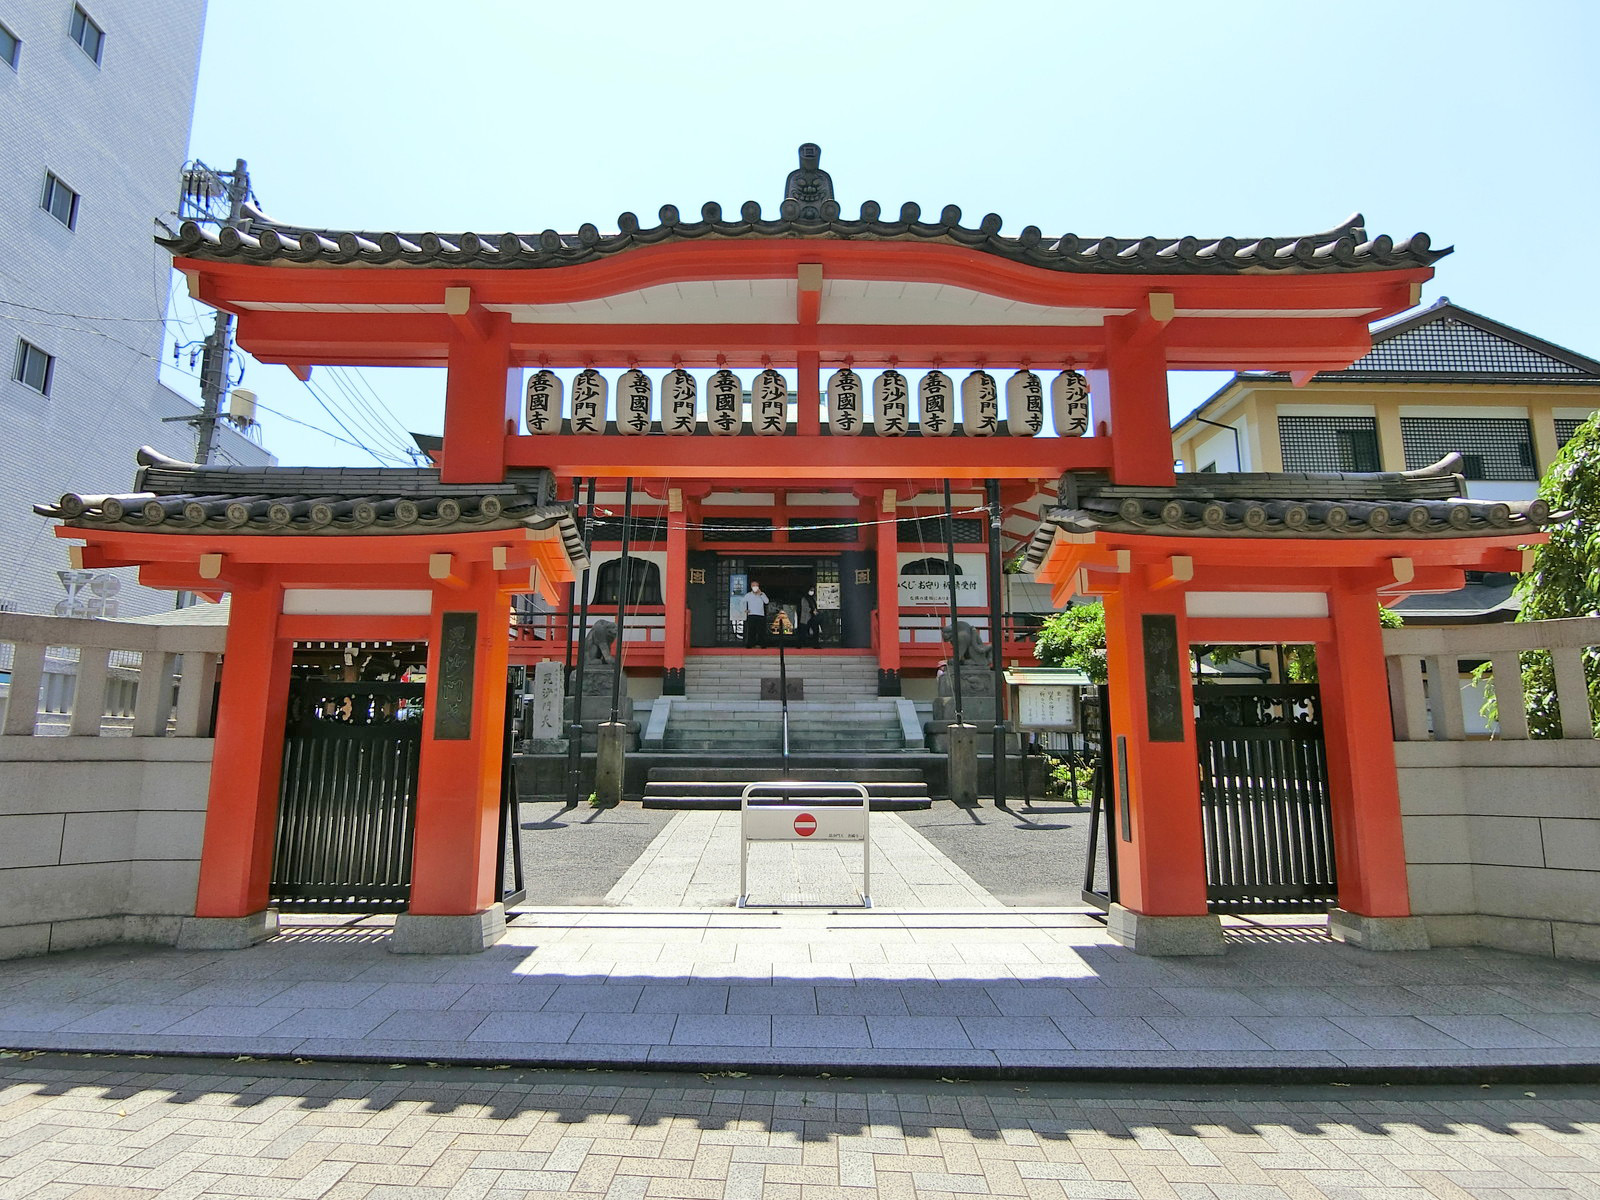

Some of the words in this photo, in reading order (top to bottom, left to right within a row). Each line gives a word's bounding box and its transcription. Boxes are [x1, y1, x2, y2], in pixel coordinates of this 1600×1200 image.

[529, 372, 553, 431] 善國寺
[627, 372, 651, 432] 善國寺
[713, 371, 738, 431] 善國寺
[835, 371, 859, 431] 善國寺
[923, 372, 948, 432] 善國寺
[1022, 372, 1043, 432] 善國寺
